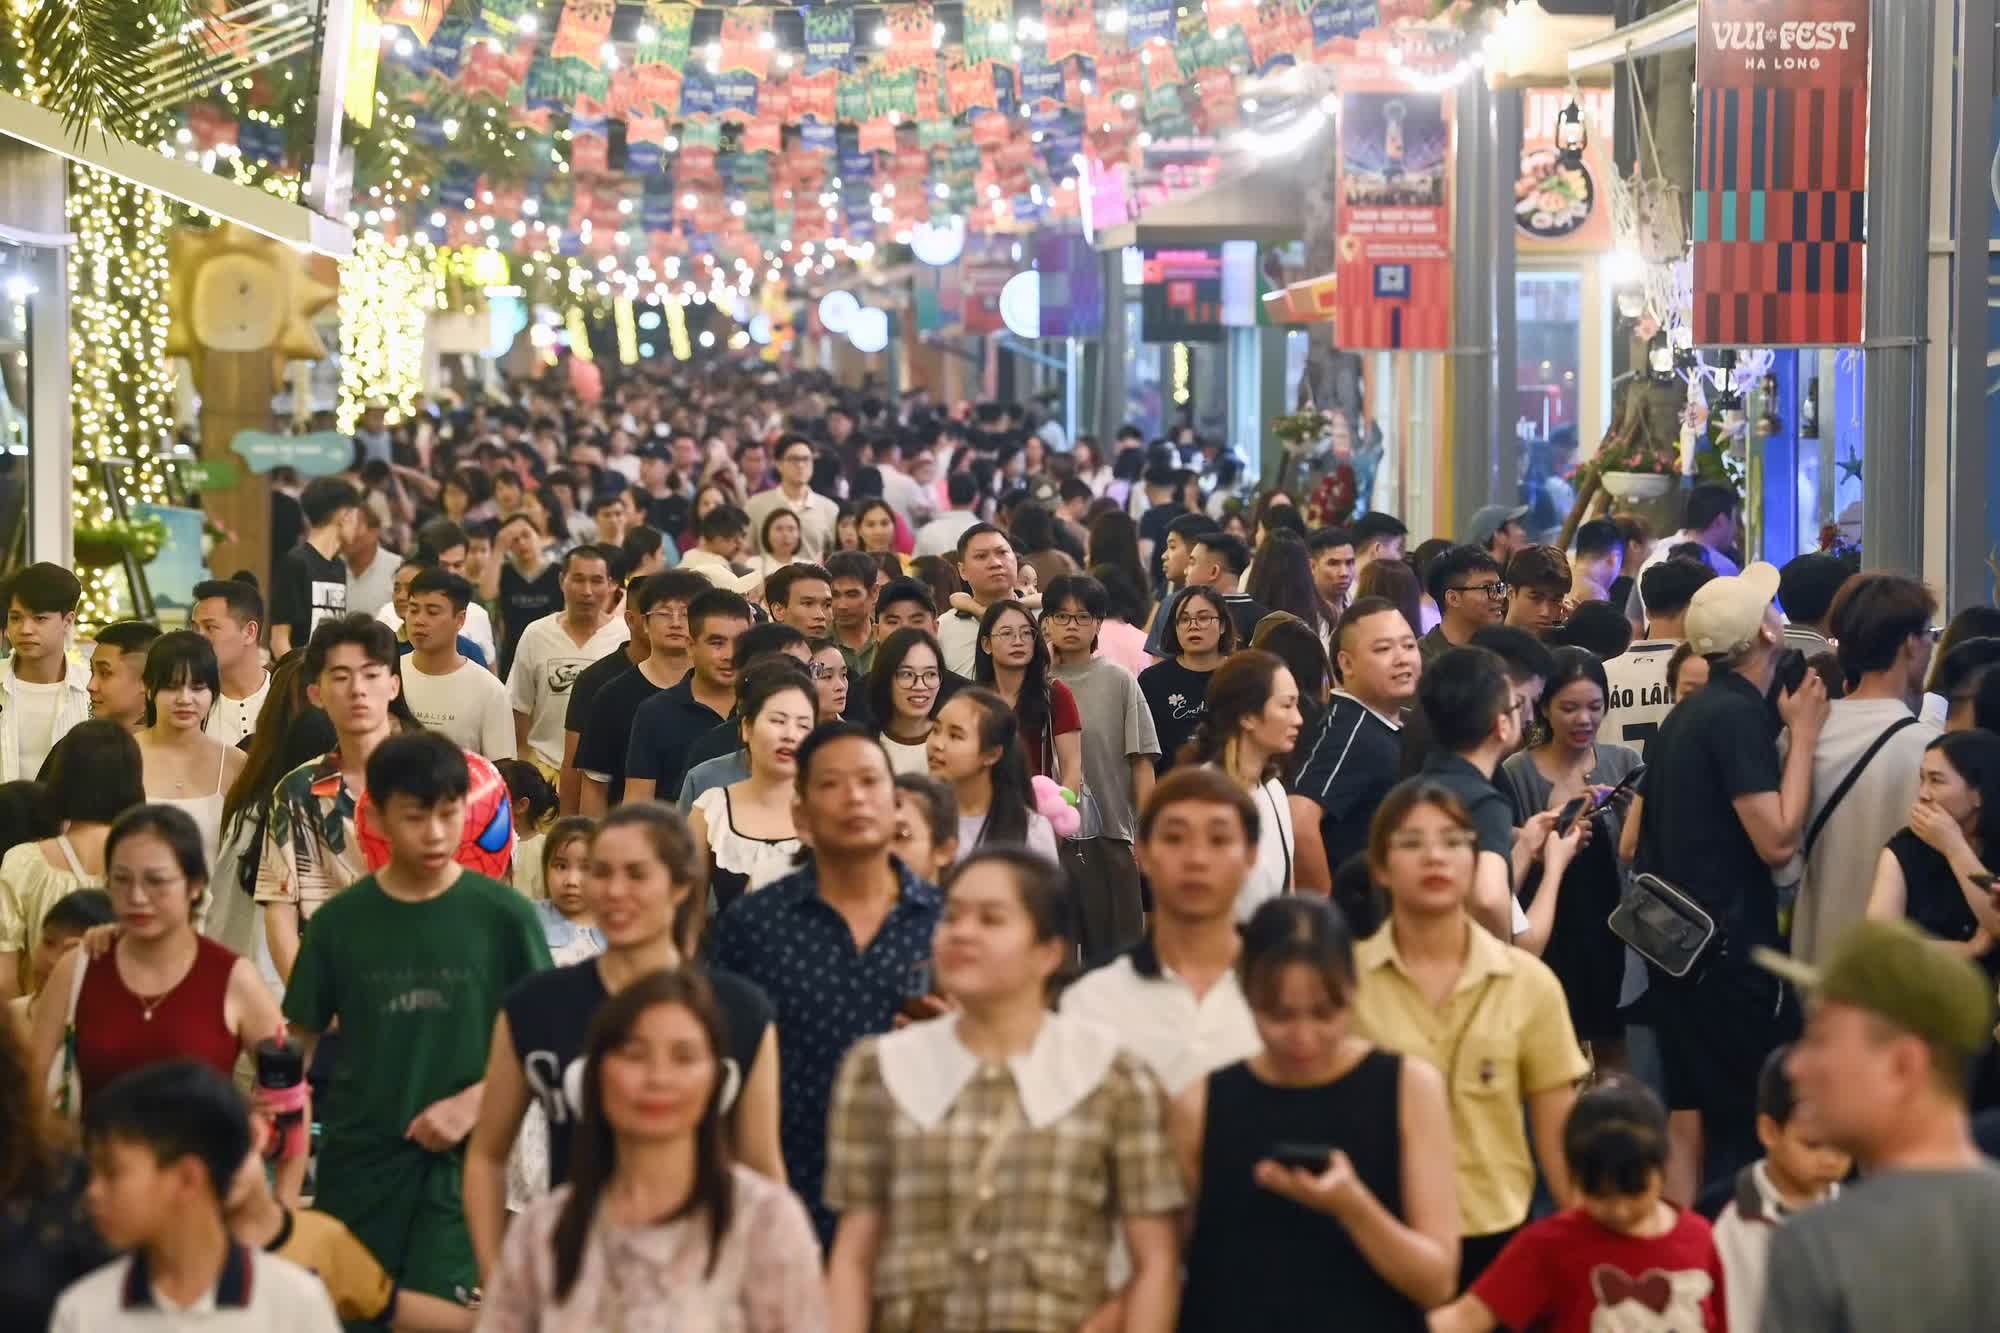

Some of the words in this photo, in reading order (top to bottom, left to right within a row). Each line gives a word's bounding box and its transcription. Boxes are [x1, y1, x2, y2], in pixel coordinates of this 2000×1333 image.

[1711, 21, 1765, 50] VUI
[1779, 21, 1856, 50] FEST
[1745, 57, 1766, 70] HA
[1774, 57, 1821, 70] LONG
[1610, 684, 1634, 709] ẢO
[415, 711, 455, 721] MALISM
